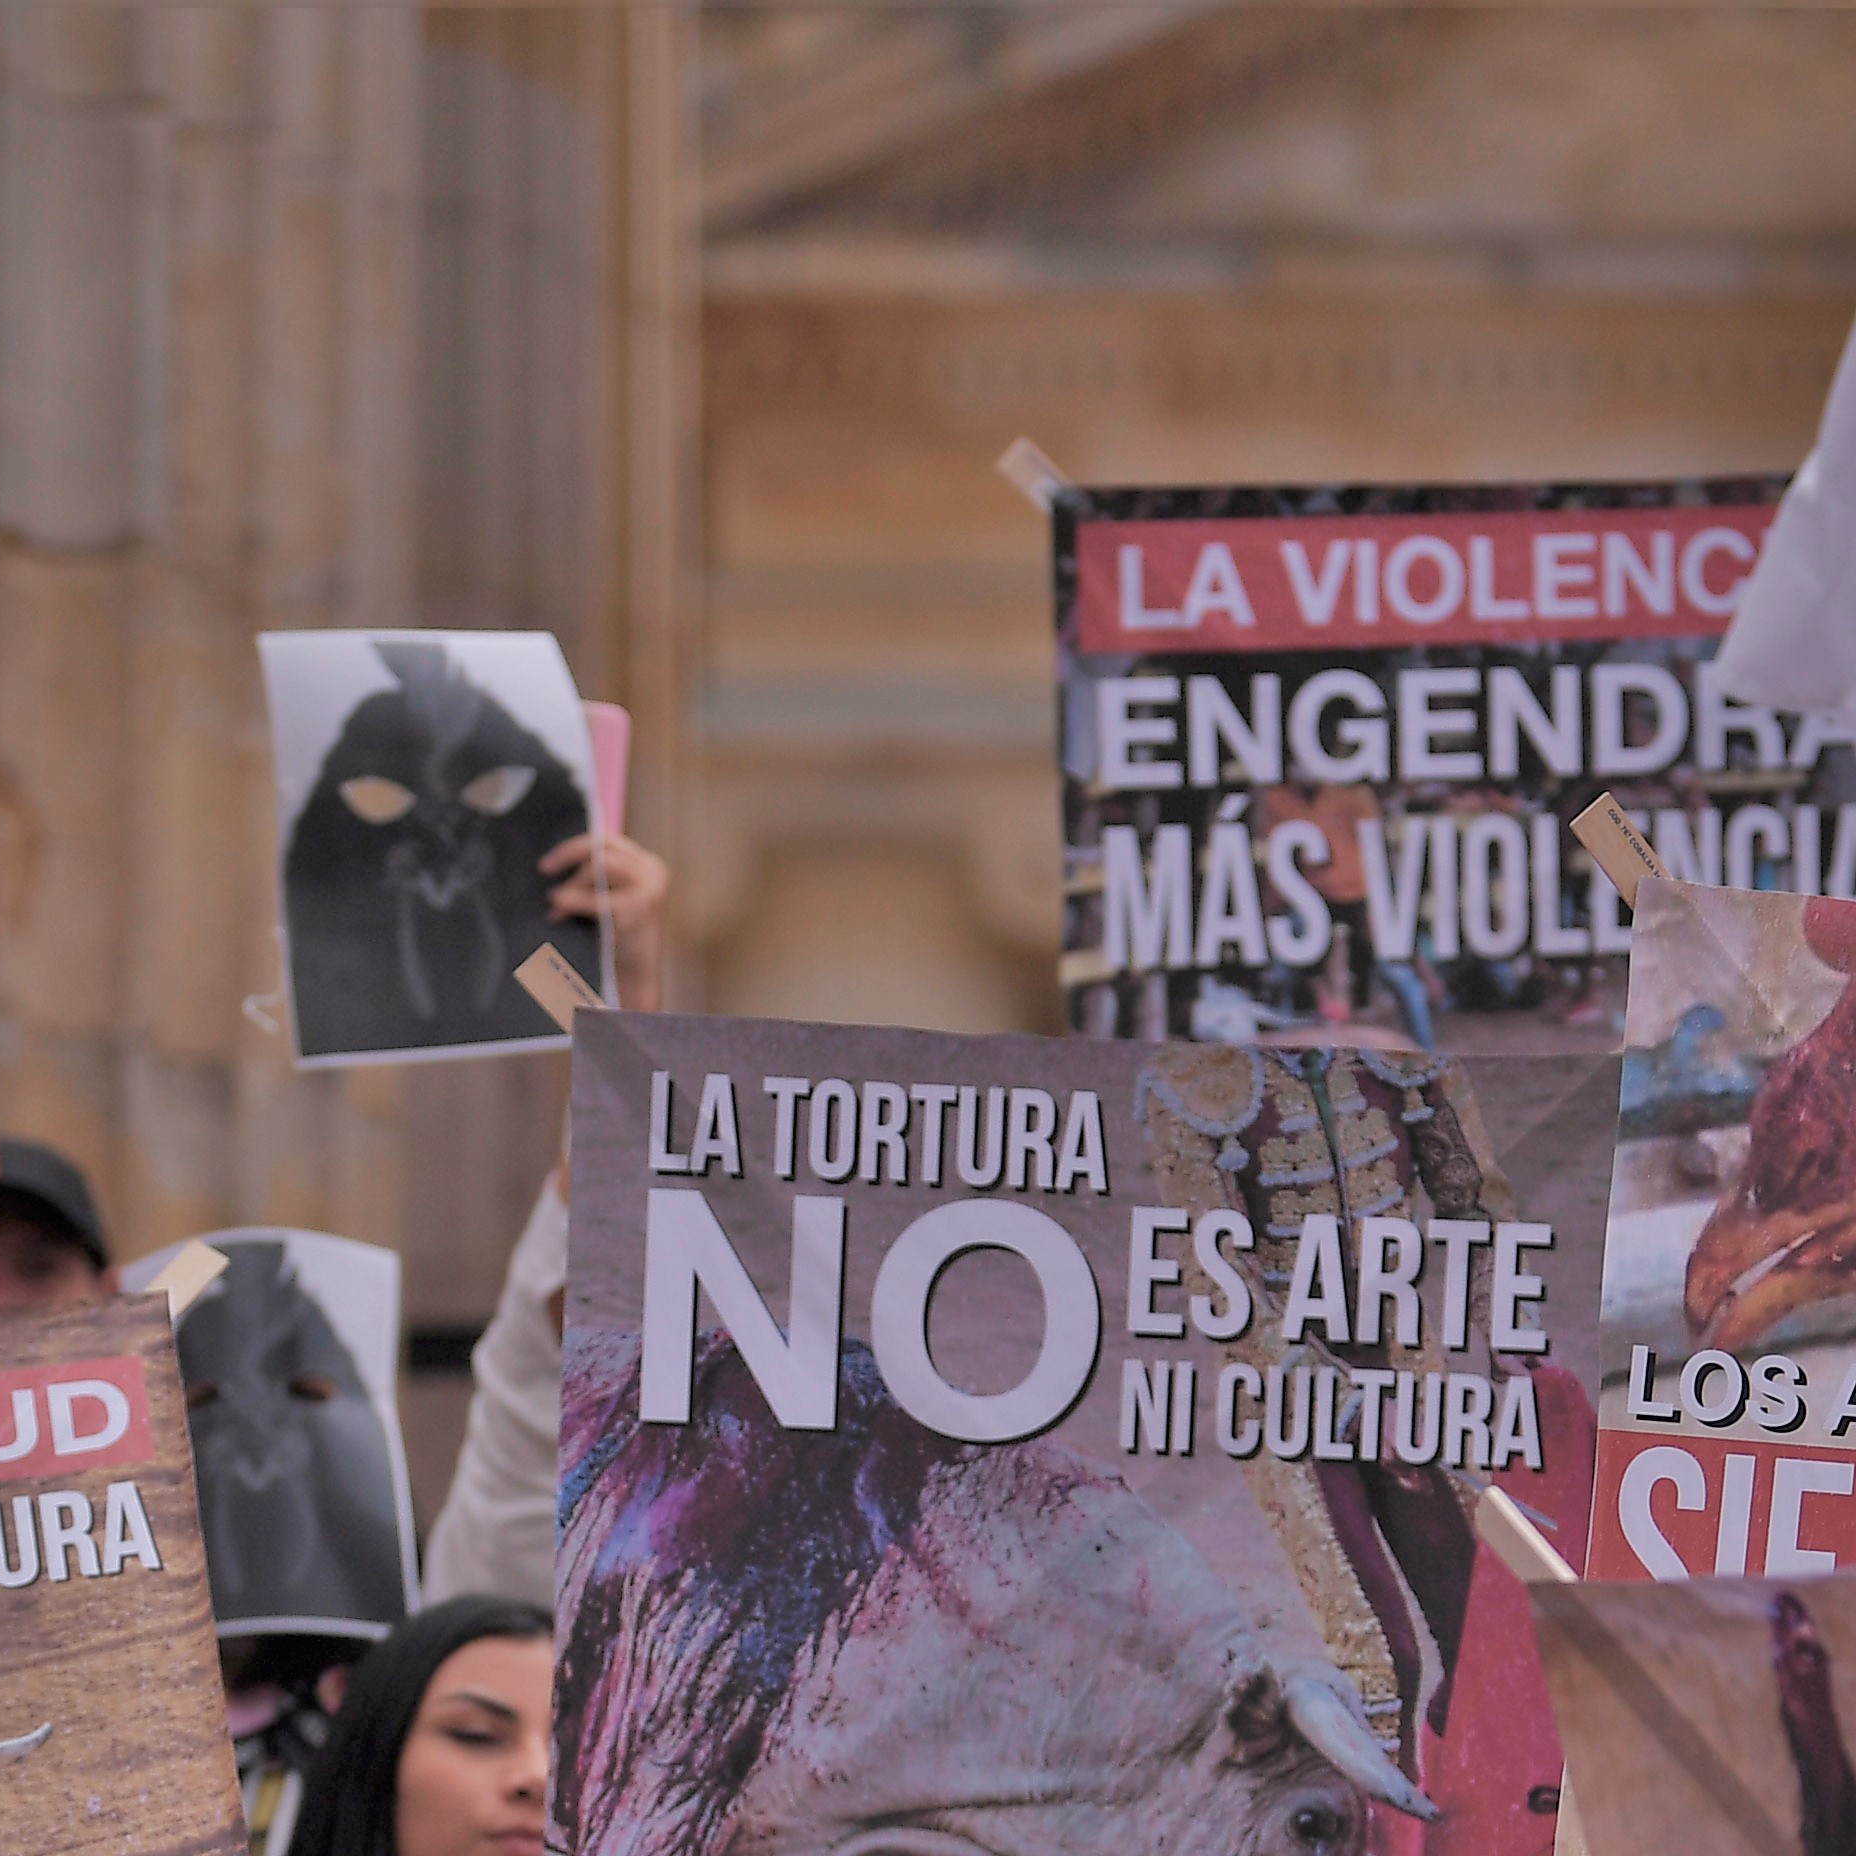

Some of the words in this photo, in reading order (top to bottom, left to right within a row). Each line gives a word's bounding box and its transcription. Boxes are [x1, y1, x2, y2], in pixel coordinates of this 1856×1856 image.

[1117, 543, 1256, 630] LA
[1279, 526, 1772, 624] VIOLENC
[1101, 791, 1333, 970] MÁS
[649, 1070, 744, 1178] LA
[763, 1075, 1111, 1195] TORTURA
[638, 1187, 1102, 1446] NO
[1128, 1206, 1256, 1342] ES
[1282, 1214, 1554, 1355] ARTE
[1119, 1358, 1195, 1457] NI
[1217, 1361, 1546, 1471] CULTURA
[1626, 1343, 1807, 1435] LOS
